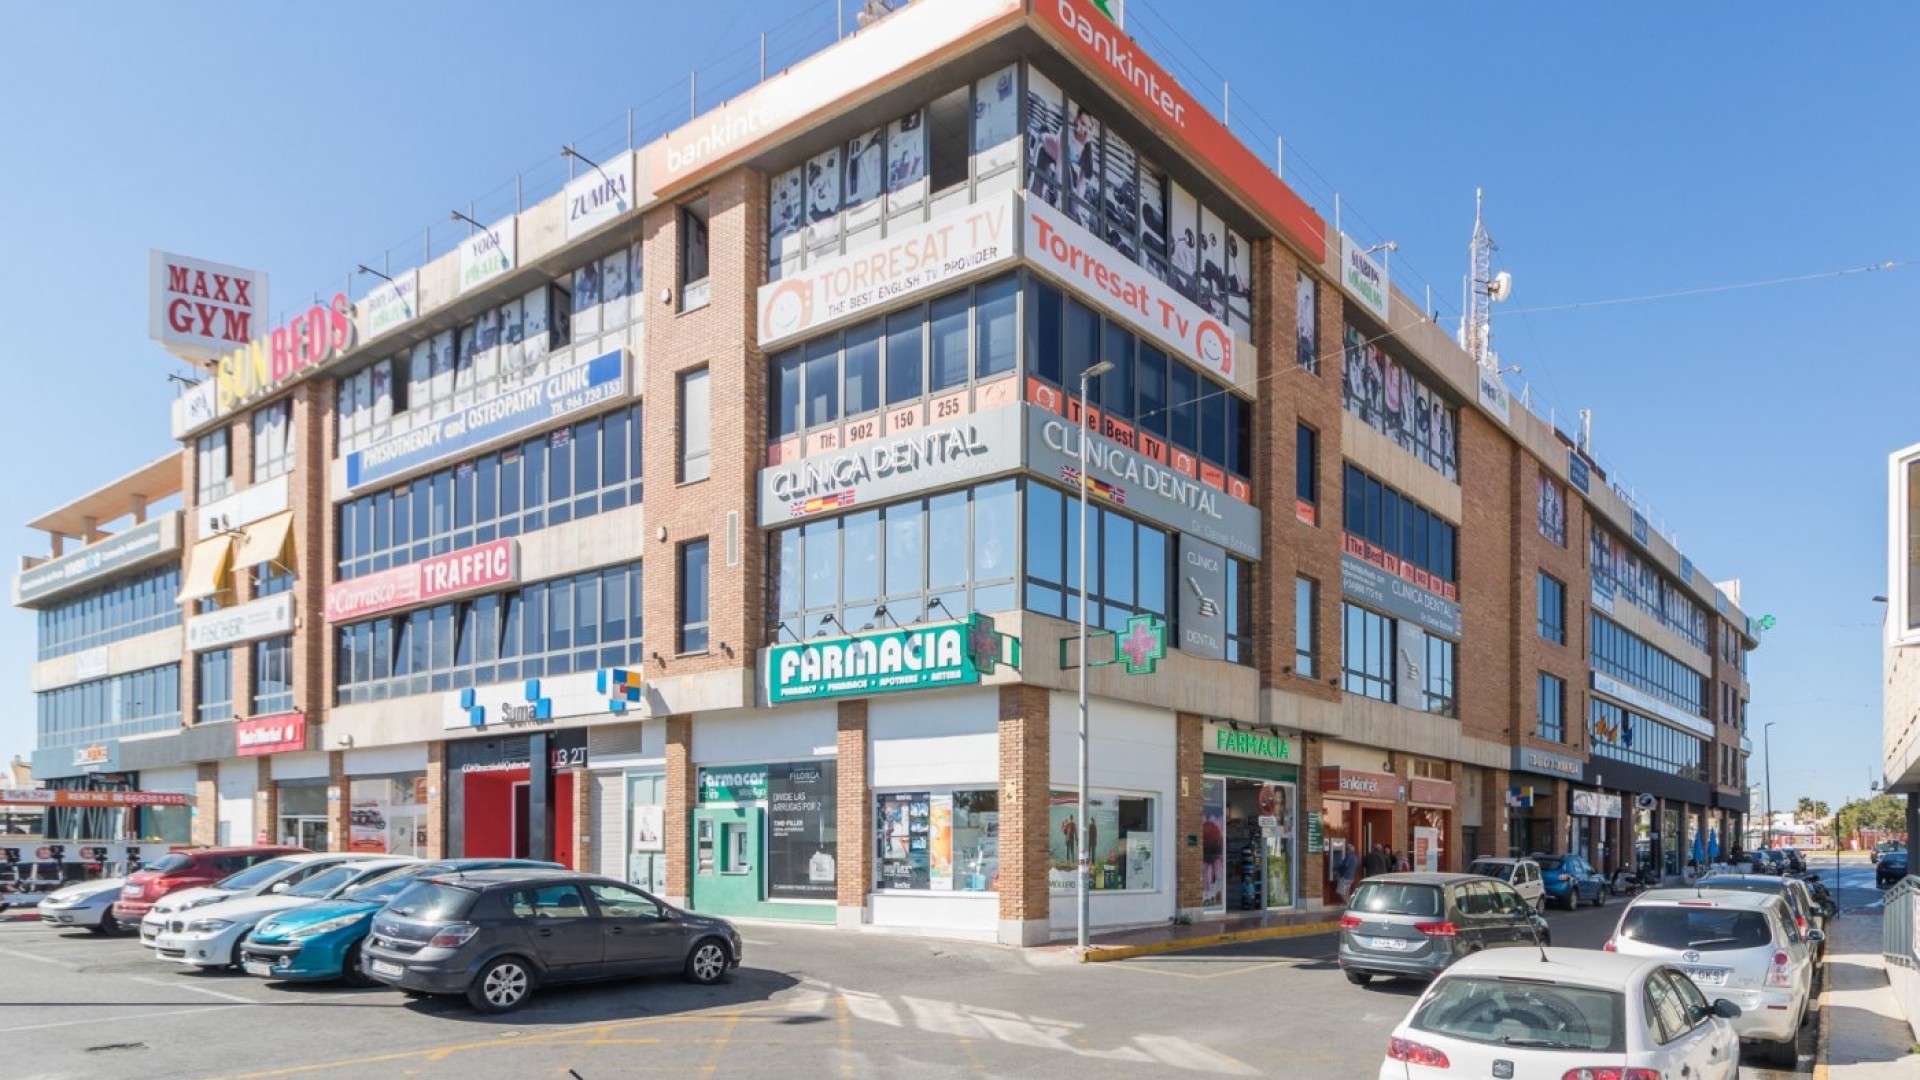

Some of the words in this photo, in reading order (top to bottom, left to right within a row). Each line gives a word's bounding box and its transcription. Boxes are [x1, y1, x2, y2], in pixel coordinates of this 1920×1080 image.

[571, 174, 627, 221] ZUMBA
[819, 224, 955, 299] TORRESAT
[966, 204, 1005, 249] TV
[167, 264, 251, 306] MAXX
[828, 301, 844, 318] THE
[850, 290, 874, 309] BEST
[878, 276, 921, 300] ENGLISH
[926, 269, 938, 282] TV
[944, 246, 998, 275] PROVIDER
[1031, 213, 1149, 316] Torresat
[1157, 298, 1189, 340] Tv
[168, 298, 251, 344] GYM
[468, 385, 544, 430] OSTEOPATHY
[546, 364, 590, 400] CLINIC
[850, 422, 873, 441] 902
[894, 411, 914, 430] 150
[938, 398, 960, 418] 255
[874, 422, 984, 473] DENTAL
[1072, 402, 1096, 430] Te
[1106, 418, 1134, 447] Best
[1145, 438, 1160, 460] TV
[1143, 463, 1222, 519] DENTAL
[425, 547, 506, 593] TRAFFIC
[780, 629, 962, 686] FARMACIA
[1186, 629, 1219, 649] DENTAL
[502, 701, 536, 722] Suma
[1217, 727, 1290, 759] FARMACIA
[773, 792, 793, 802] DIVIDE
[794, 791, 806, 801] LAS
[773, 802, 801, 812] ARRUGAS
